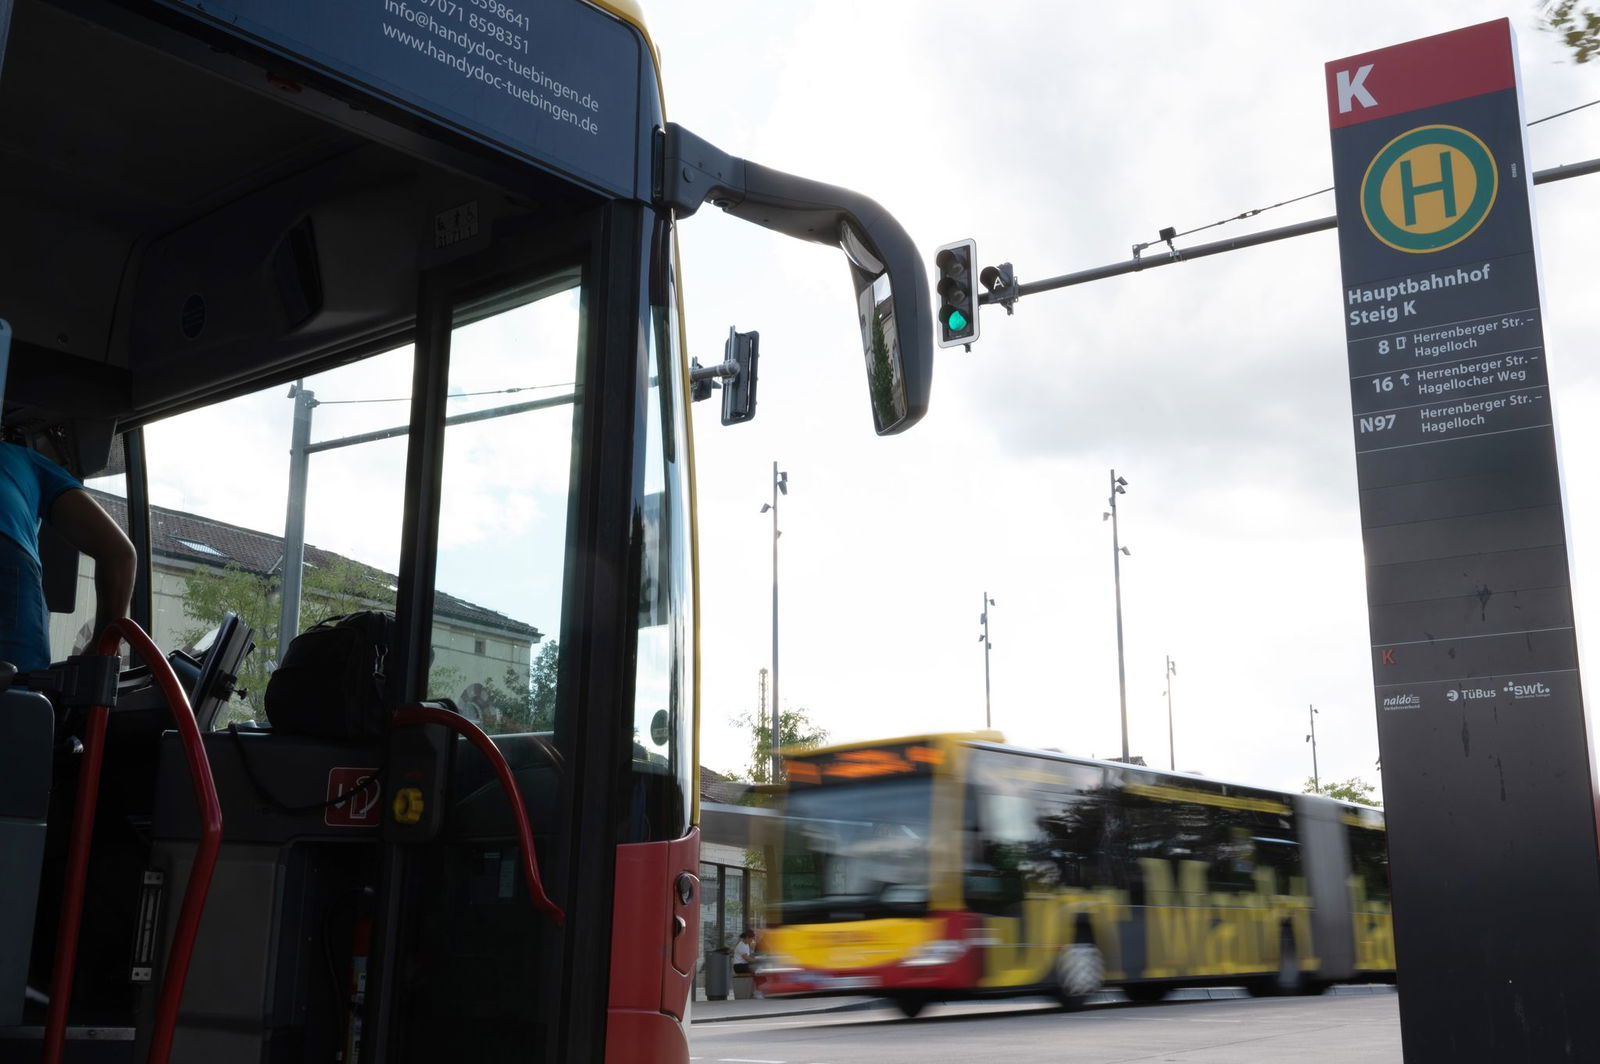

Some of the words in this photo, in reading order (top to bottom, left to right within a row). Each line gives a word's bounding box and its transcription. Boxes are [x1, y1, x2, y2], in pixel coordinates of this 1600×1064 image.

[469, 14, 529, 54] 8598351
[382, 23, 599, 135] www.handydoc-tuebingen.de
[1336, 63, 1378, 114] K
[1400, 151, 1457, 227] H
[1348, 263, 1491, 305] Hauptbahnhof
[1349, 304, 1398, 326] Steig
[1403, 300, 1417, 317] K
[1413, 321, 1498, 344] Herrenberger
[1501, 317, 1524, 330] Str.
[1378, 340, 1390, 355] 8
[1414, 338, 1478, 358] Hagelloch
[1417, 360, 1502, 382] Herrenberger
[1505, 355, 1528, 367] Str.
[1372, 376, 1394, 393] 16
[1418, 374, 1494, 395] Hagellocher
[1497, 369, 1527, 383] Weg
[1420, 398, 1506, 420] Herrenberger
[1509, 393, 1532, 405] Str.
[1359, 414, 1397, 433] N97
[1421, 413, 1485, 433] Hagelloch
[1382, 649, 1396, 665] K
[1383, 693, 1412, 706] naldo
[1461, 688, 1497, 700] TüBus
